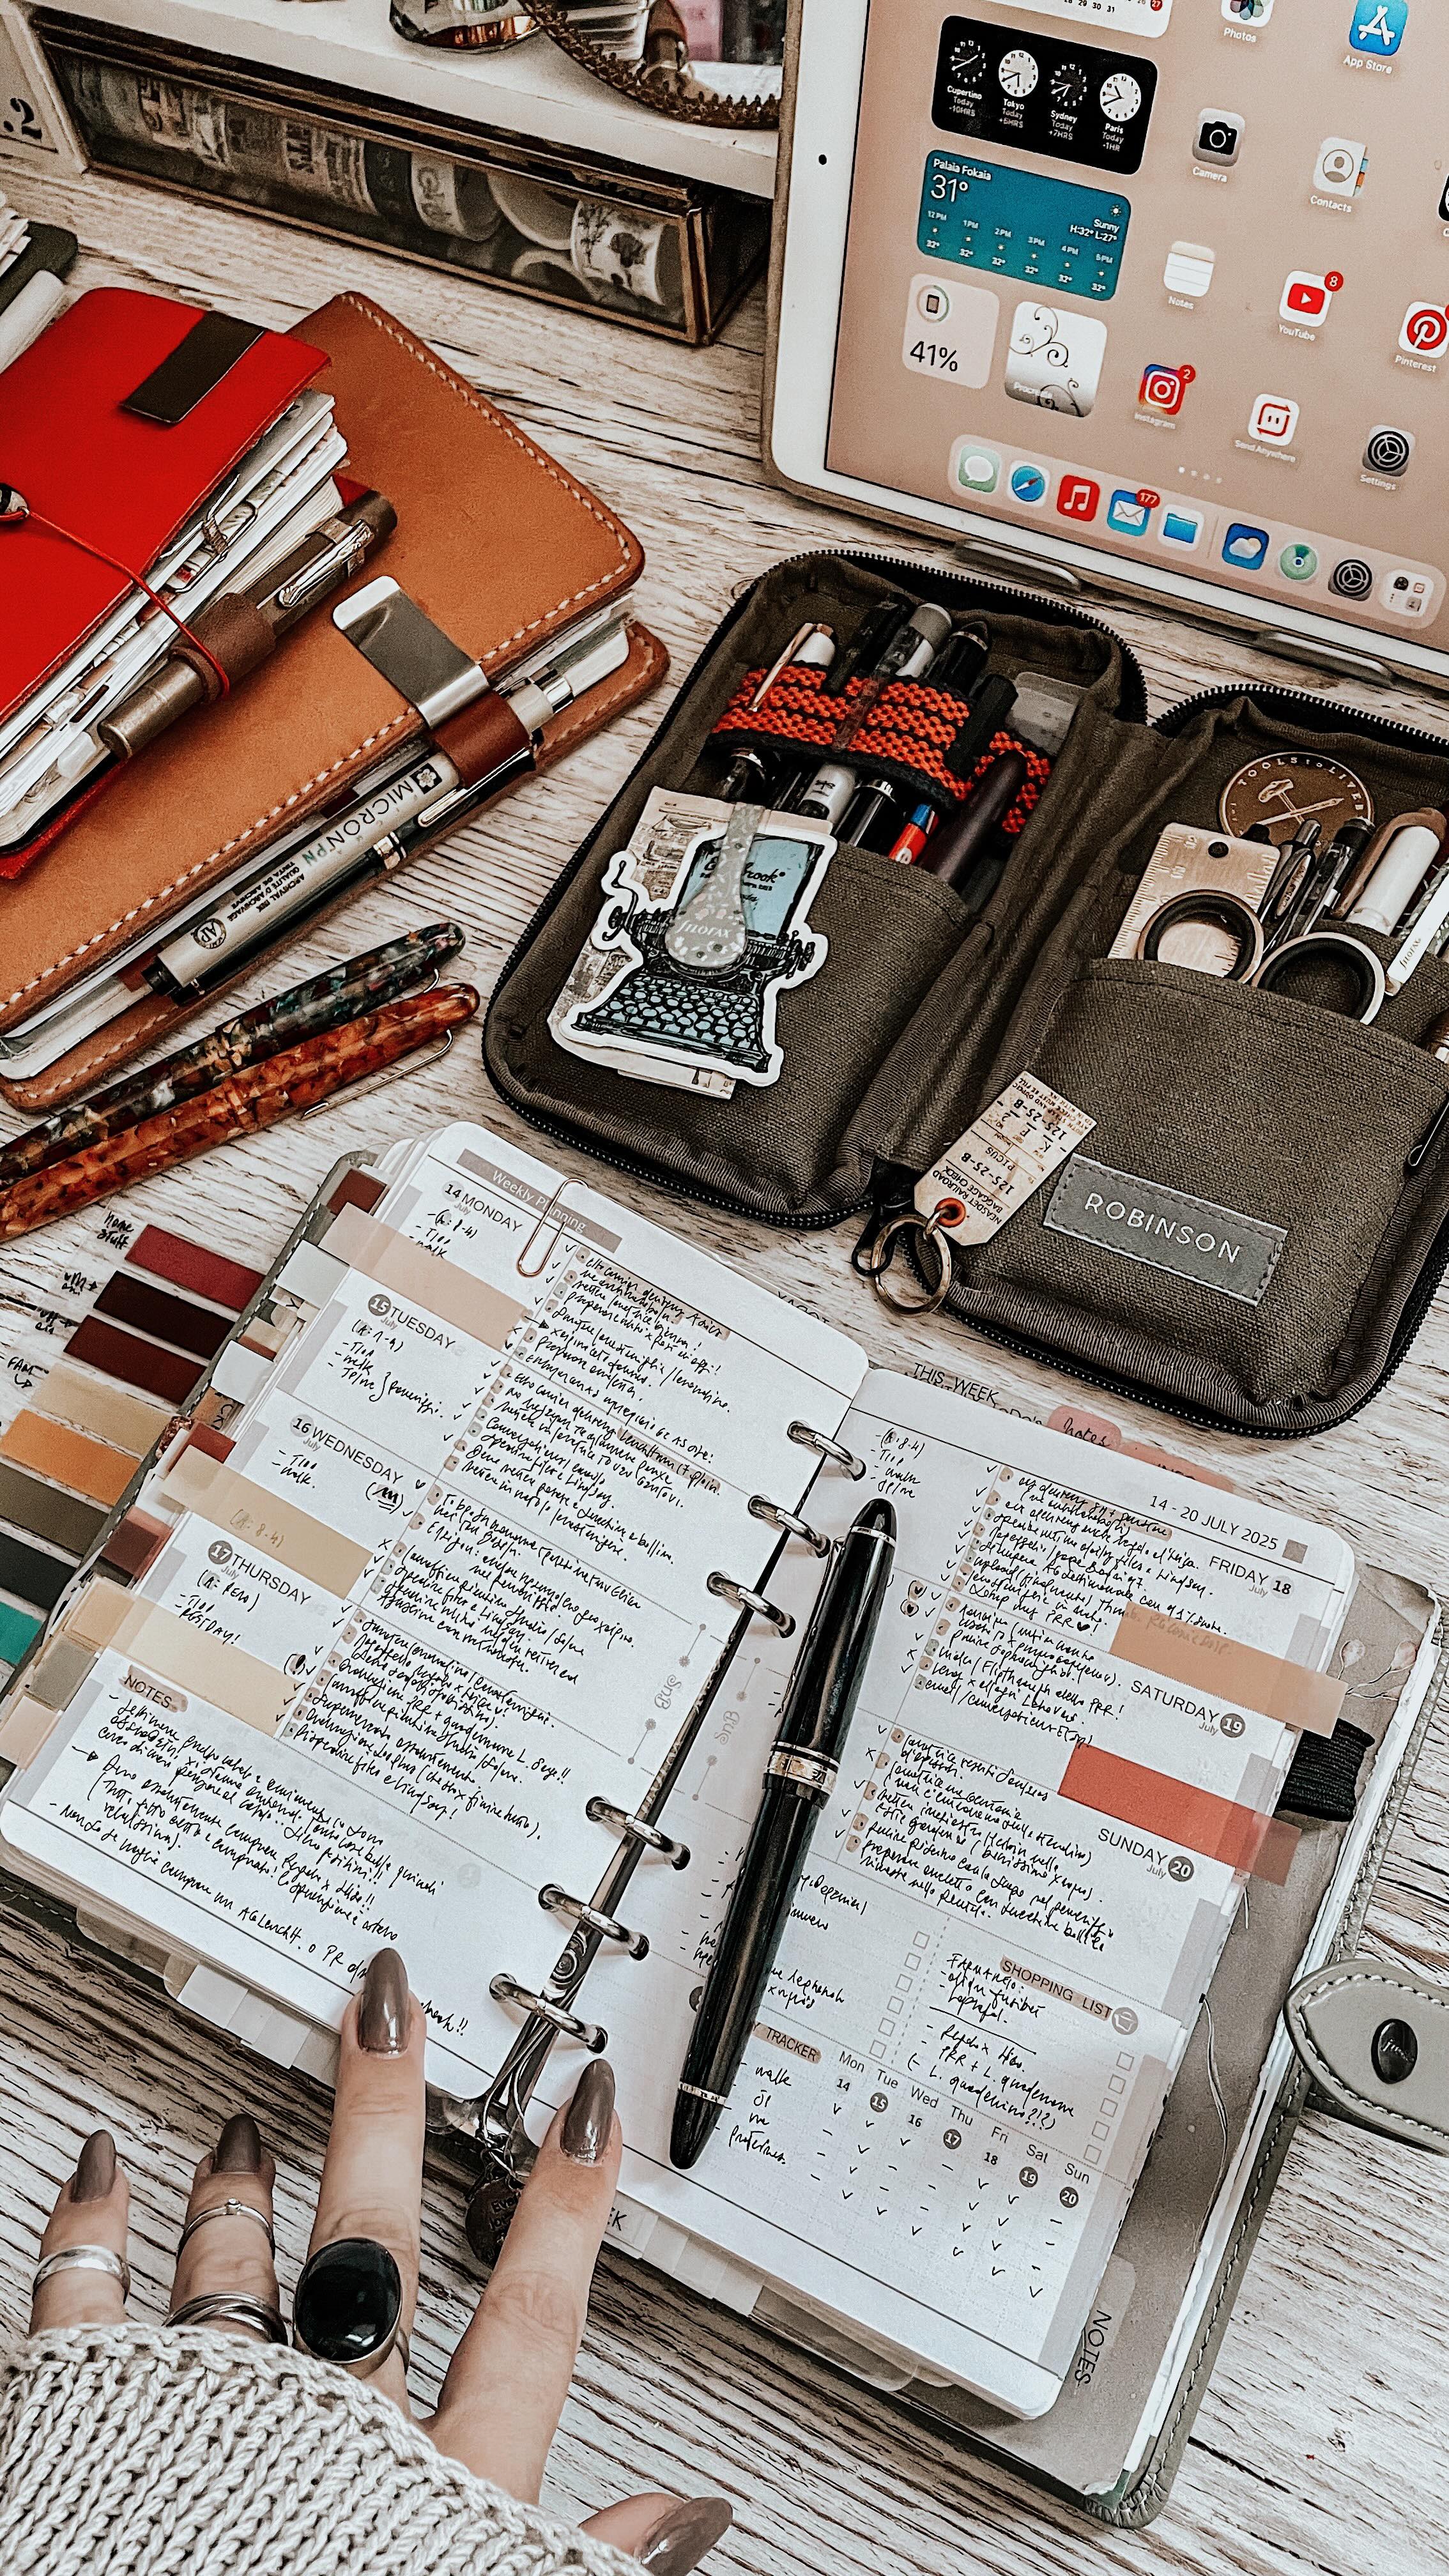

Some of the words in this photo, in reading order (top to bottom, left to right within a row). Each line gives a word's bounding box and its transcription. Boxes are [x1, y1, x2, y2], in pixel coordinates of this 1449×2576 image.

[1223, 27, 1257, 43] Photos
[1343, 55, 1363, 70] App
[1365, 60, 1393, 74] Store
[954, 96, 974, 108] Today
[1004, 98, 1024, 110] Tokyo
[1002, 108, 1022, 119] Today
[1050, 110, 1077, 123] Sydney
[1052, 119, 1073, 132] Today
[1105, 123, 1123, 134] Paris
[1103, 132, 1124, 144] Today
[933, 159, 960, 174] Palaia
[962, 165, 992, 181] Fokaia
[1192, 167, 1227, 183] Camera
[1310, 195, 1352, 213] Contacts
[1094, 218, 1119, 233] Sunny
[1330, 276, 1338, 287] 8
[1169, 296, 1195, 310] Notes
[1278, 325, 1315, 341] YouTube
[910, 341, 958, 372] 41%
[1395, 355, 1436, 372] Pinterest
[1135, 413, 1176, 429] Instagram
[1234, 440, 1257, 452] Send
[1257, 445, 1296, 463] Anywhere
[1360, 474, 1397, 491] Settings
[1139, 493, 1158, 504] 177
[323, 778, 417, 850] MICRON
[300, 841, 329, 868] PN
[1018, 1077, 1031, 1089] FILL
[1034, 1098, 1046, 1109] AND
[1039, 1092, 1056, 1107] MUST
[1012, 1097, 1067, 1142] 125-25-B
[984, 1145, 1016, 1172] PICUS
[942, 1165, 969, 1188] CHECK
[960, 1150, 1015, 1196] 125-25-B
[489, 1170, 536, 1204] Weekly
[930, 1169, 969, 1200] RAILROAD
[443, 1183, 462, 1199] 14
[460, 1193, 523, 1234] MONDAY
[453, 1200, 472, 1216] July
[967, 1184, 1004, 1214] BAGGAGE
[967, 1196, 1002, 1225] NEASDET
[1084, 1192, 1241, 1265] ROBINSON
[369, 1296, 390, 1315] 15
[387, 1305, 456, 1352] TUESDAY
[379, 1315, 399, 1332] July
[910, 1361, 946, 1385] THIS
[951, 1376, 1000, 1405] WEEK
[292, 1416, 312, 1435] 16
[309, 1426, 404, 1487] WEDNESDAY
[301, 1436, 321, 1453] July
[1149, 1494, 1169, 1512] 14
[1179, 1505, 1200, 1523] 20
[1200, 1513, 1240, 1537] JULY
[1240, 1527, 1279, 1552] 2025
[210, 1542, 231, 1563] 17
[228, 1552, 312, 1607] THURSDAY
[220, 1563, 241, 1581] July
[1208, 1555, 1269, 1587] FRIDAY
[1271, 1579, 1292, 1596] 18
[1247, 1583, 1269, 1599] July
[123, 1673, 174, 1710] NOTES
[1130, 1678, 1219, 1725] SATURDAY
[1220, 1715, 1242, 1735] 19
[1197, 1720, 1220, 1737] July
[1096, 1827, 1169, 1867] SUNDAY
[1169, 1859, 1193, 1880] 20
[1144, 1862, 1167, 1881] July
[1000, 1959, 1077, 2002] SHOPPING
[1080, 1997, 1114, 2020] LIST
[762, 2027, 820, 2062] TRACKER
[837, 2051, 867, 2073] Mon
[873, 2067, 901, 2090] Tue
[907, 2085, 940, 2109] Wed
[947, 2104, 975, 2126] Thu
[990, 2126, 1010, 2144] Fri
[1024, 2143, 1050, 2163] Sat
[1062, 2161, 1092, 2185] Sun
[836, 2078, 851, 2092] 14
[870, 2095, 887, 2111] 15
[907, 2113, 924, 2129] 16
[943, 2131, 961, 2147] 17
[982, 2150, 1000, 2166] 18
[1020, 2169, 1038, 2186] 19
[1060, 2189, 1078, 2205] 20
[1075, 2310, 1112, 2384] NOTES
